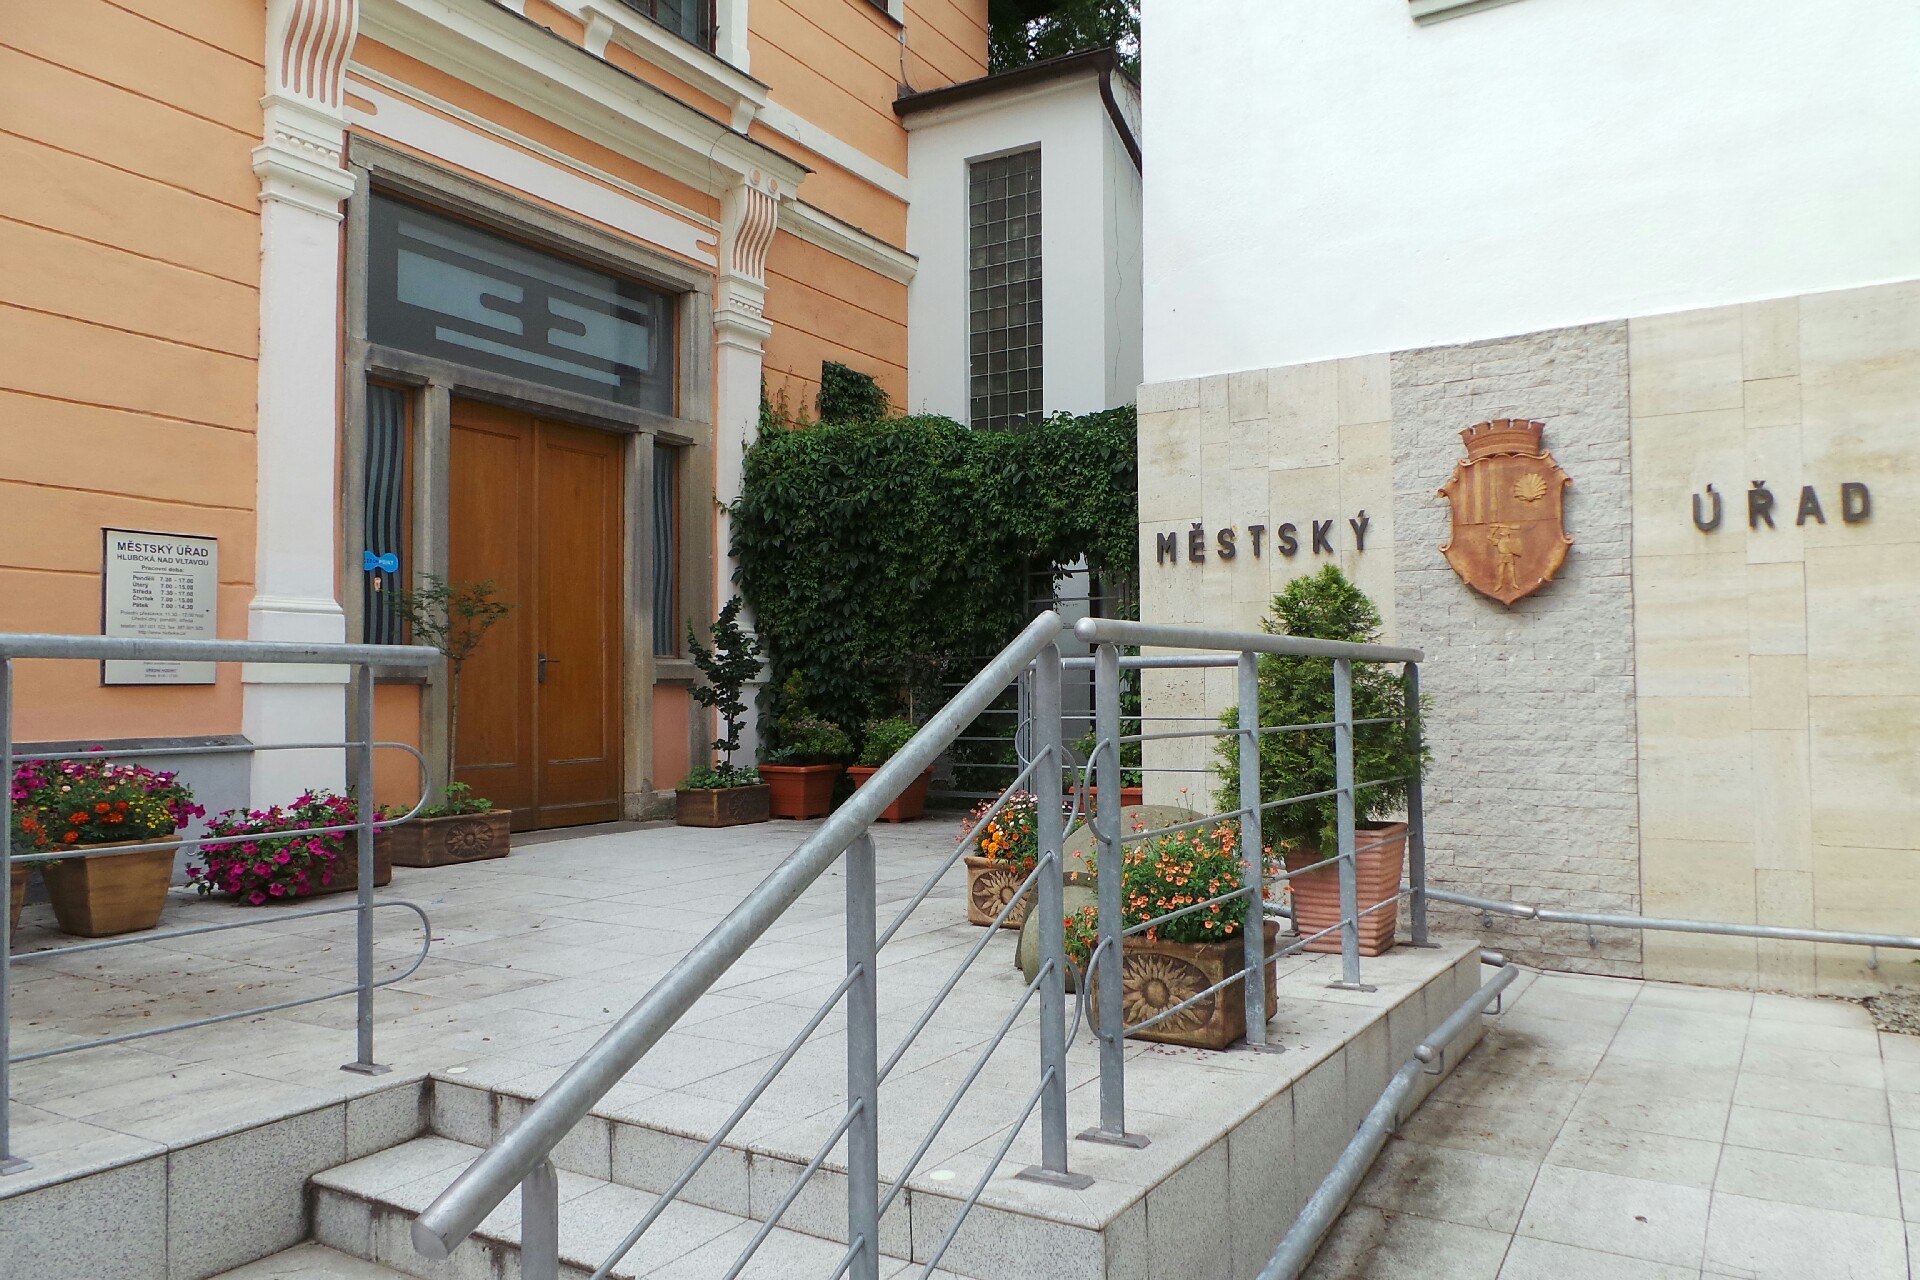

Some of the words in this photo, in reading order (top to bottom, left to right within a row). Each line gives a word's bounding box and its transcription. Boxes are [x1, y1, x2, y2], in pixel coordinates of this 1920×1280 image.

[1156, 510, 1370, 564] MĚSTSKÝ
[1692, 480, 1870, 532] ÚŘAD
[117, 540, 173, 554] MĚSTSKÝ
[176, 544, 208, 557] ÚŘAD
[117, 553, 155, 562] HLUBOKÁ
[157, 556, 173, 564] NAD
[175, 557, 208, 566] VLTAVOU
